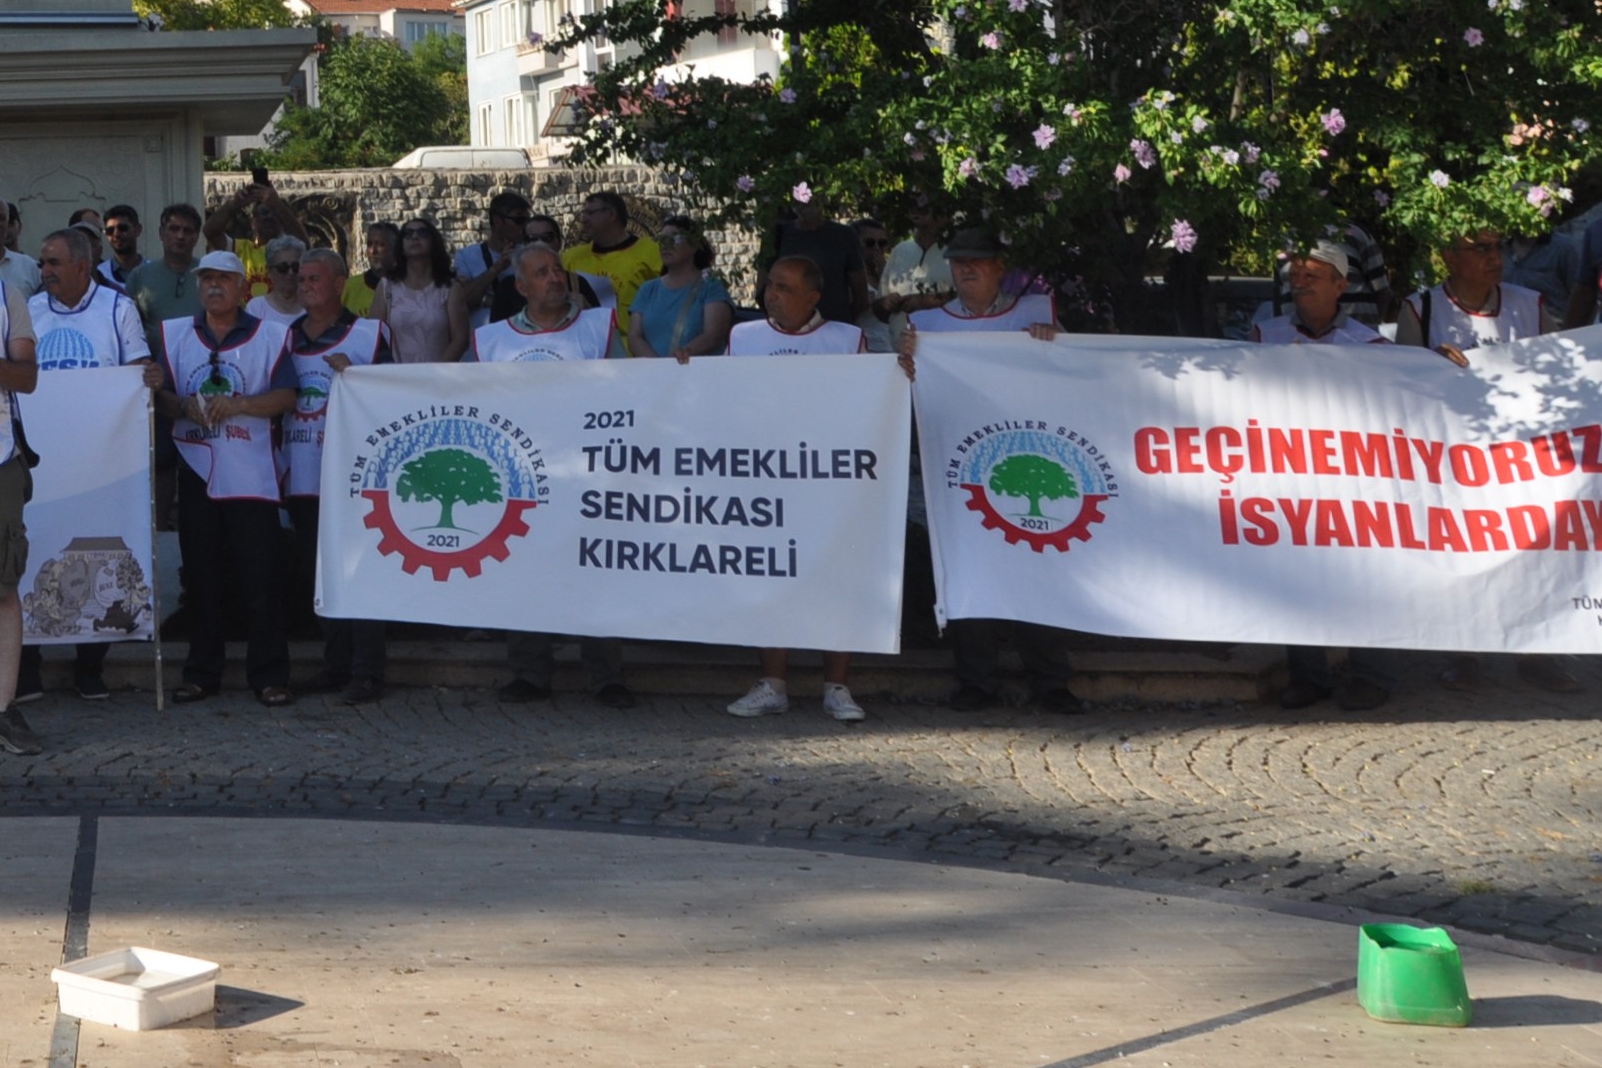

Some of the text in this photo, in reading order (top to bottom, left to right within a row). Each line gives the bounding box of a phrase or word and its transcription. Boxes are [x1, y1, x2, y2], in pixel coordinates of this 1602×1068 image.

[583, 410, 635, 430] 2021
[349, 455, 367, 498] TÜM
[365, 405, 480, 448] EMEKLİLER
[489, 412, 550, 505] SENDİKASI
[582, 437, 878, 480] TÜM EMEKLİLER
[946, 419, 1120, 499] TÜM EMEKLİLER SENDİKASI
[1133, 418, 1602, 488] GEÇİNEMİYORUZ
[580, 486, 784, 528] SENDİKASI
[1019, 516, 1050, 531] 2021
[426, 533, 461, 548] 2021
[578, 537, 798, 578] KIRKLARELİ
